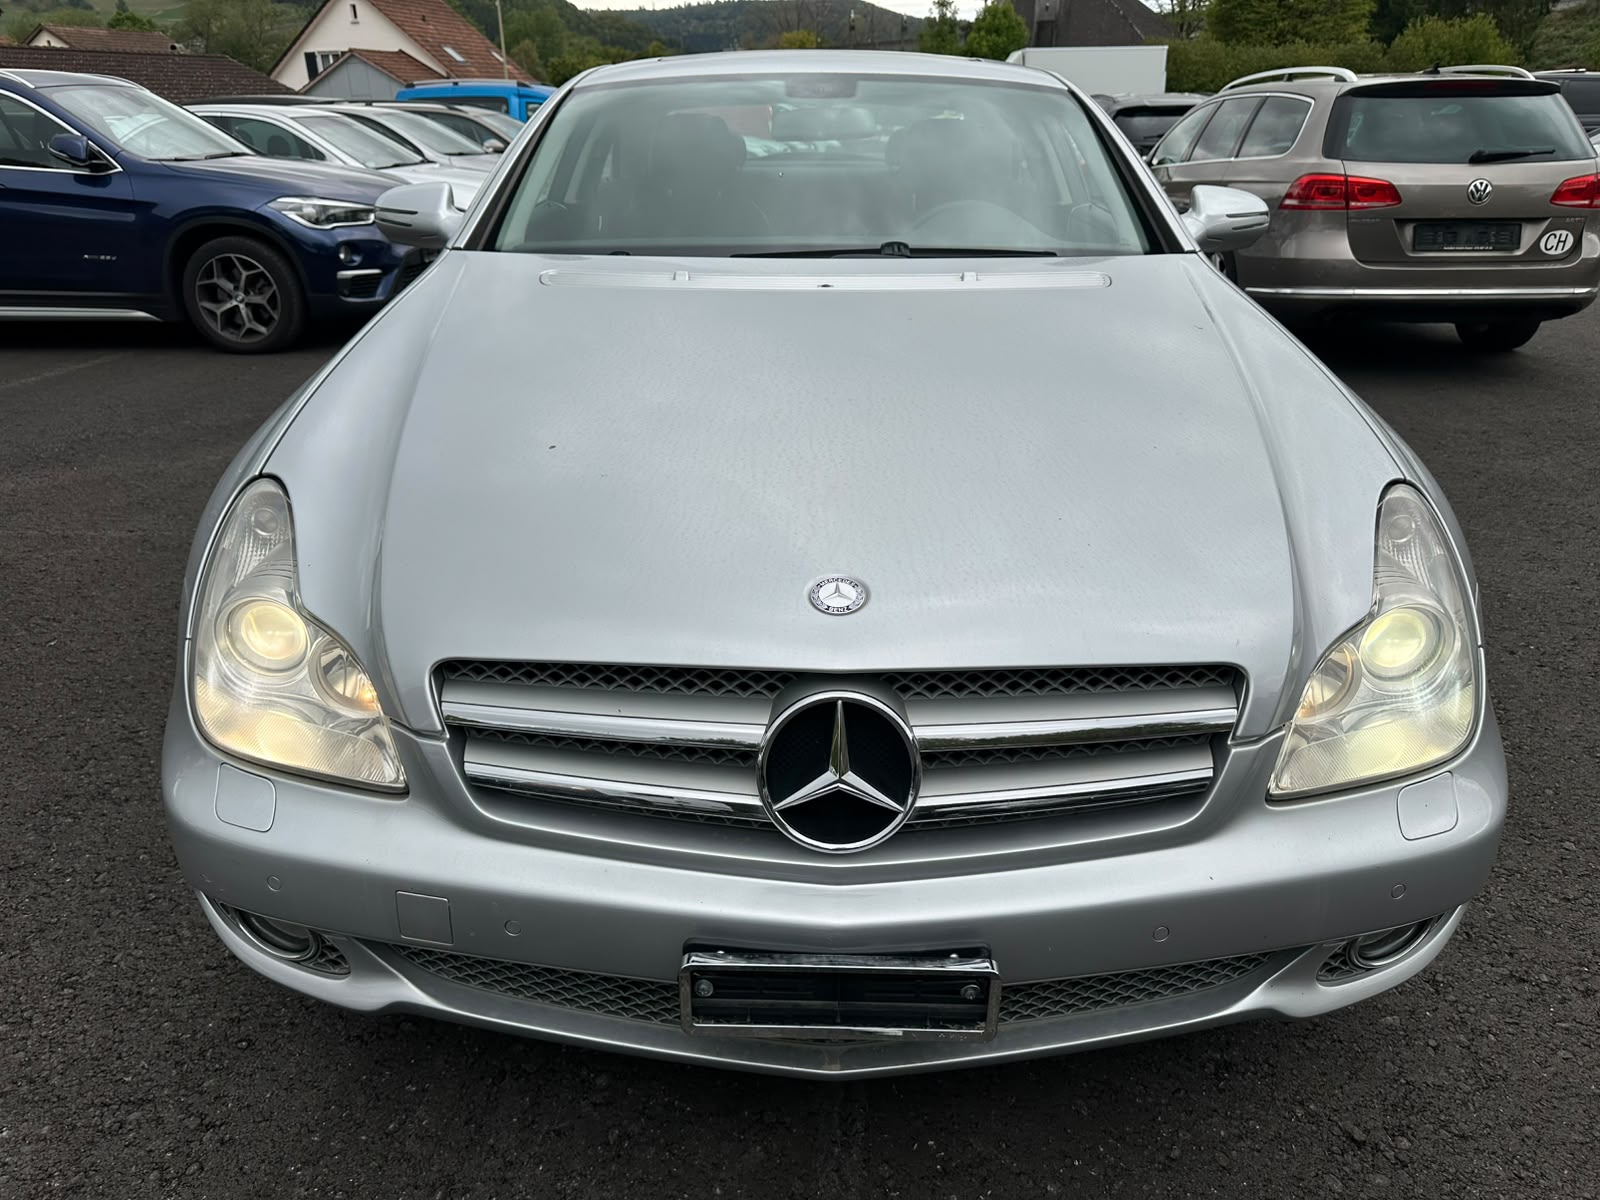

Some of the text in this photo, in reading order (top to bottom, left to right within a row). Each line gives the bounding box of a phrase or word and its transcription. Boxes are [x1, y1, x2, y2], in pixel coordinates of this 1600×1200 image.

[1545, 233, 1568, 251] CH
[819, 577, 857, 588] MERCEDES
[828, 605, 848, 613] BENZ
